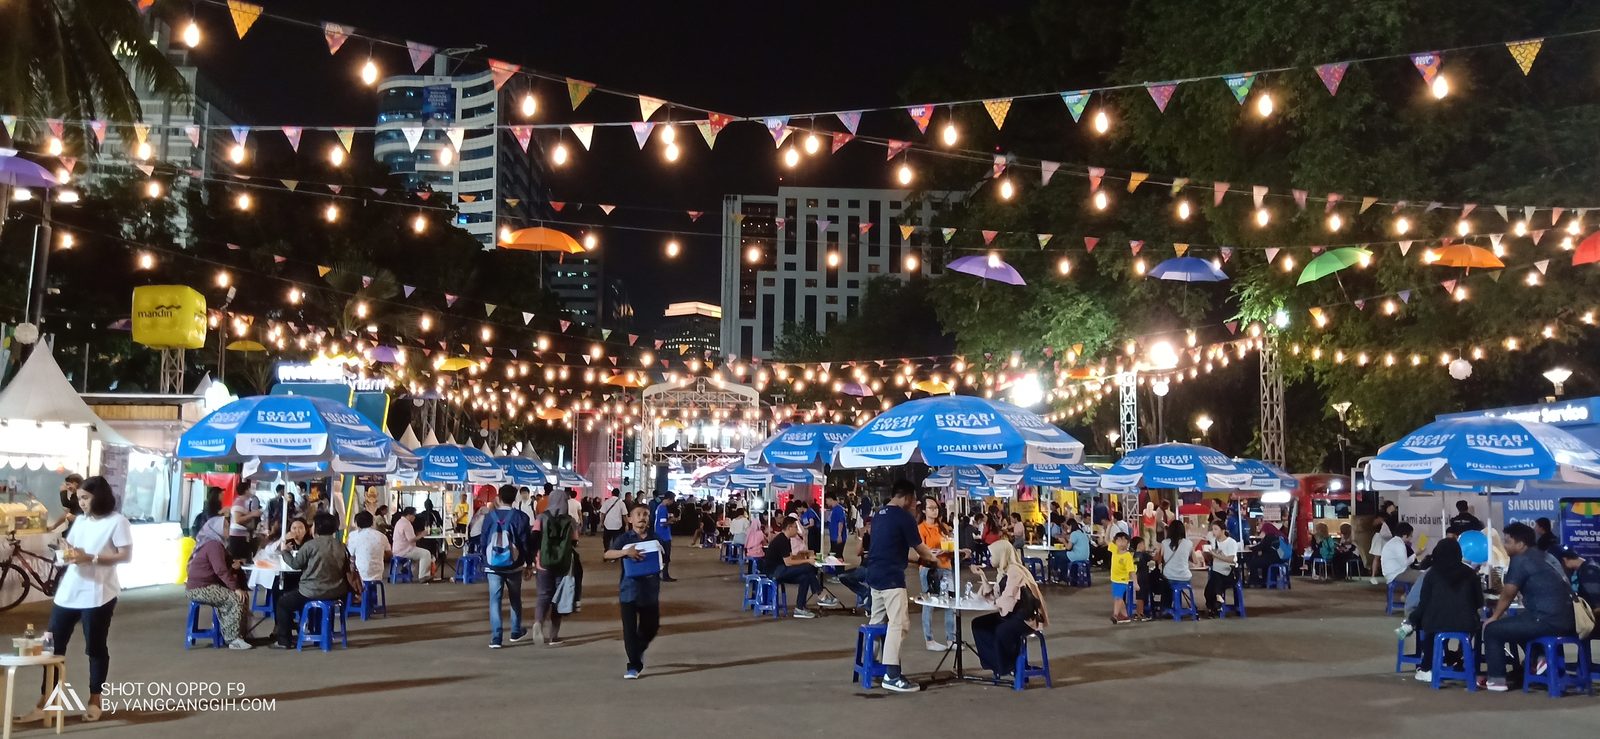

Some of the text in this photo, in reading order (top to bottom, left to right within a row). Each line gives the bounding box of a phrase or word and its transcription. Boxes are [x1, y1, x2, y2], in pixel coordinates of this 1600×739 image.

[934, 413, 996, 421] POCARI
[1541, 404, 1589, 423] Service
[876, 415, 924, 425] POCARI
[936, 419, 989, 427] SWEAT
[871, 420, 915, 431] SWEAT
[1465, 434, 1529, 442] POCARI
[937, 443, 1004, 452] POCARI SWEAT
[1508, 499, 1554, 511] SAMSUNG
[1401, 513, 1418, 525] Kami
[1418, 514, 1432, 525] ada
